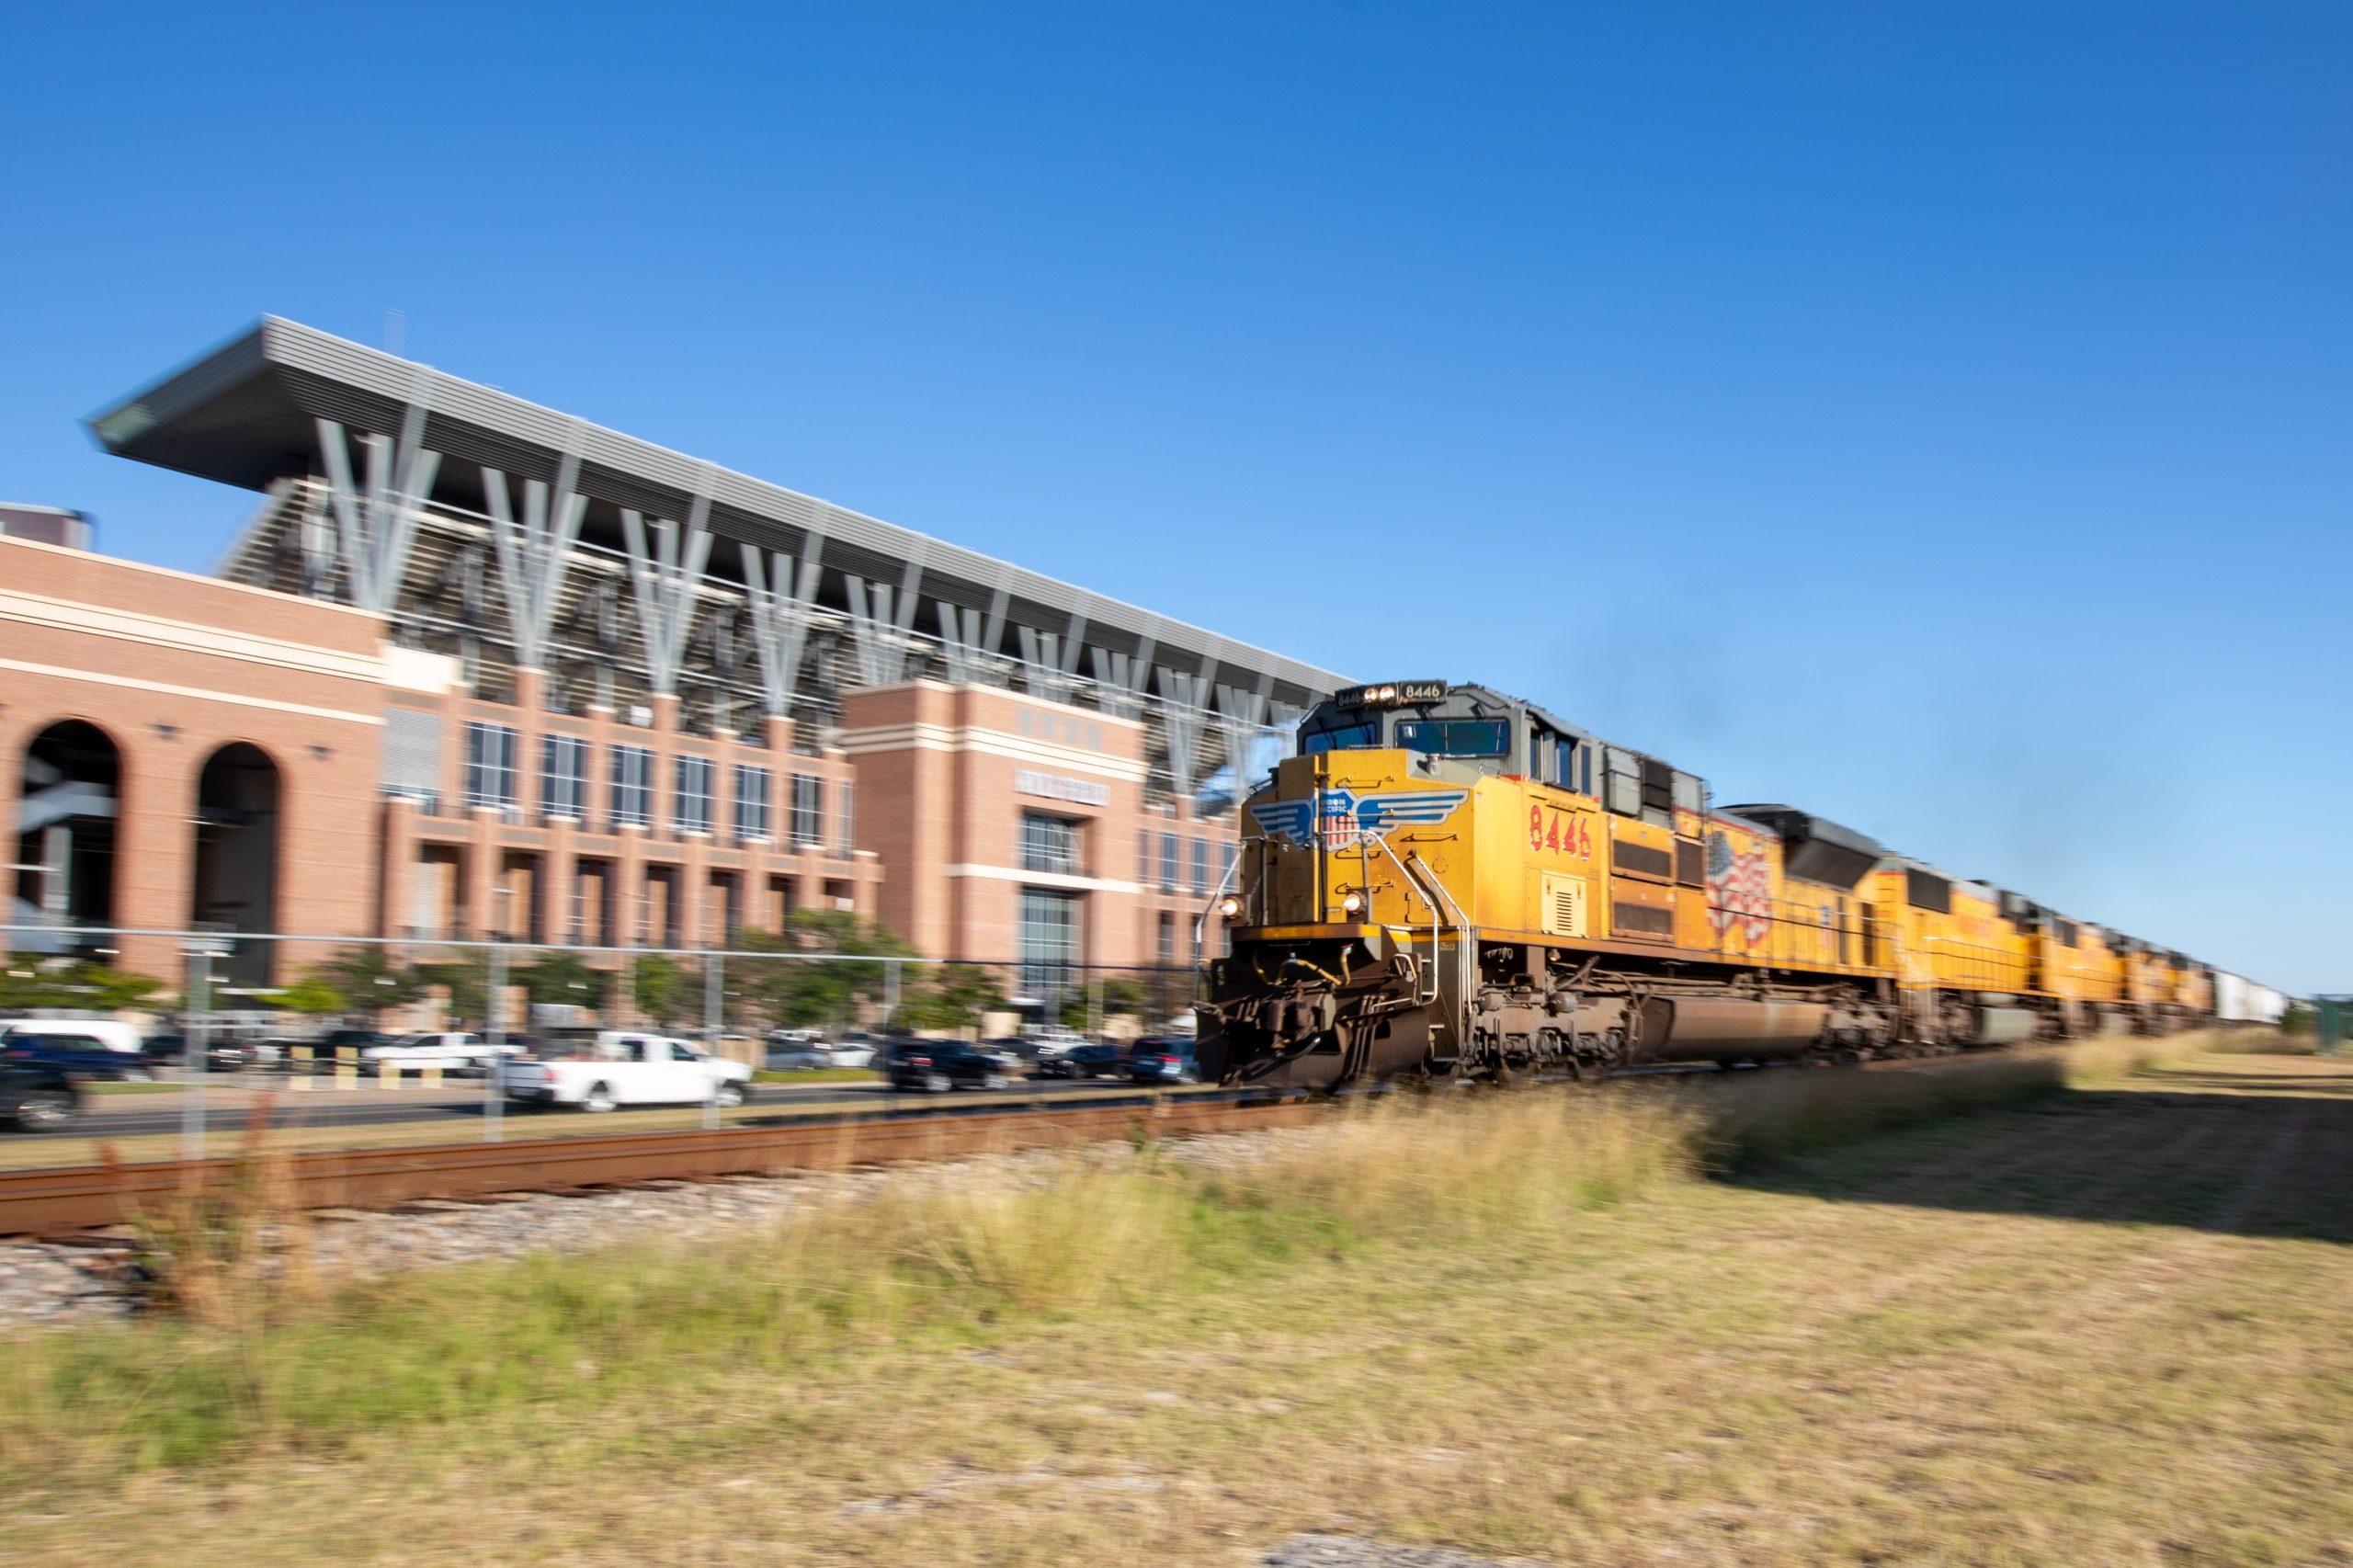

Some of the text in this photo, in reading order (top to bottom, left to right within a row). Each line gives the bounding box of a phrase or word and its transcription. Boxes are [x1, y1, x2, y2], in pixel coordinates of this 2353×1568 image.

[1338, 691, 1360, 707] 8446
[1405, 685, 1440, 699] 8446
[1529, 804, 1591, 861] 8446
